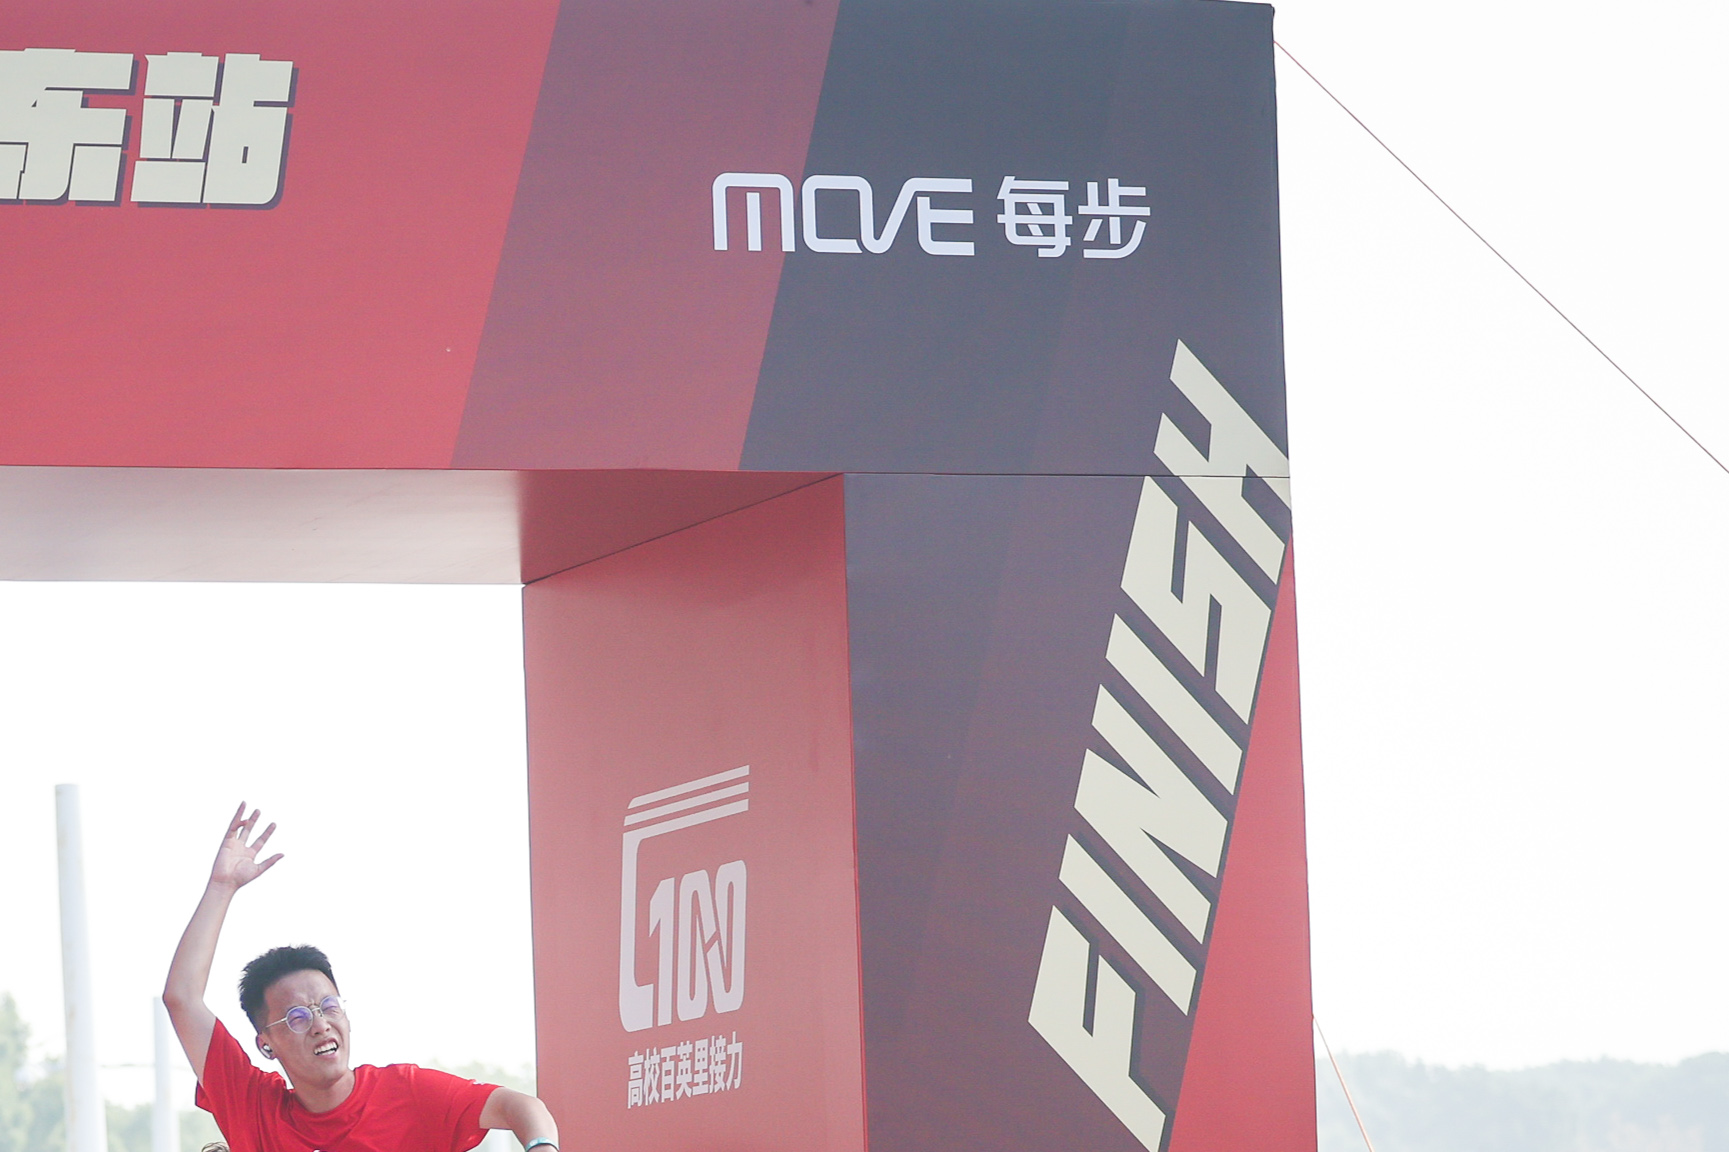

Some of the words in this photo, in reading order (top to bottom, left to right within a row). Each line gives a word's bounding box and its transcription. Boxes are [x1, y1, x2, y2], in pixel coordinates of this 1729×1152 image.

[712, 172, 975, 257] MOVE
[996, 175, 1151, 259] 每步
[627, 1032, 743, 1109] 高校百英里接力
